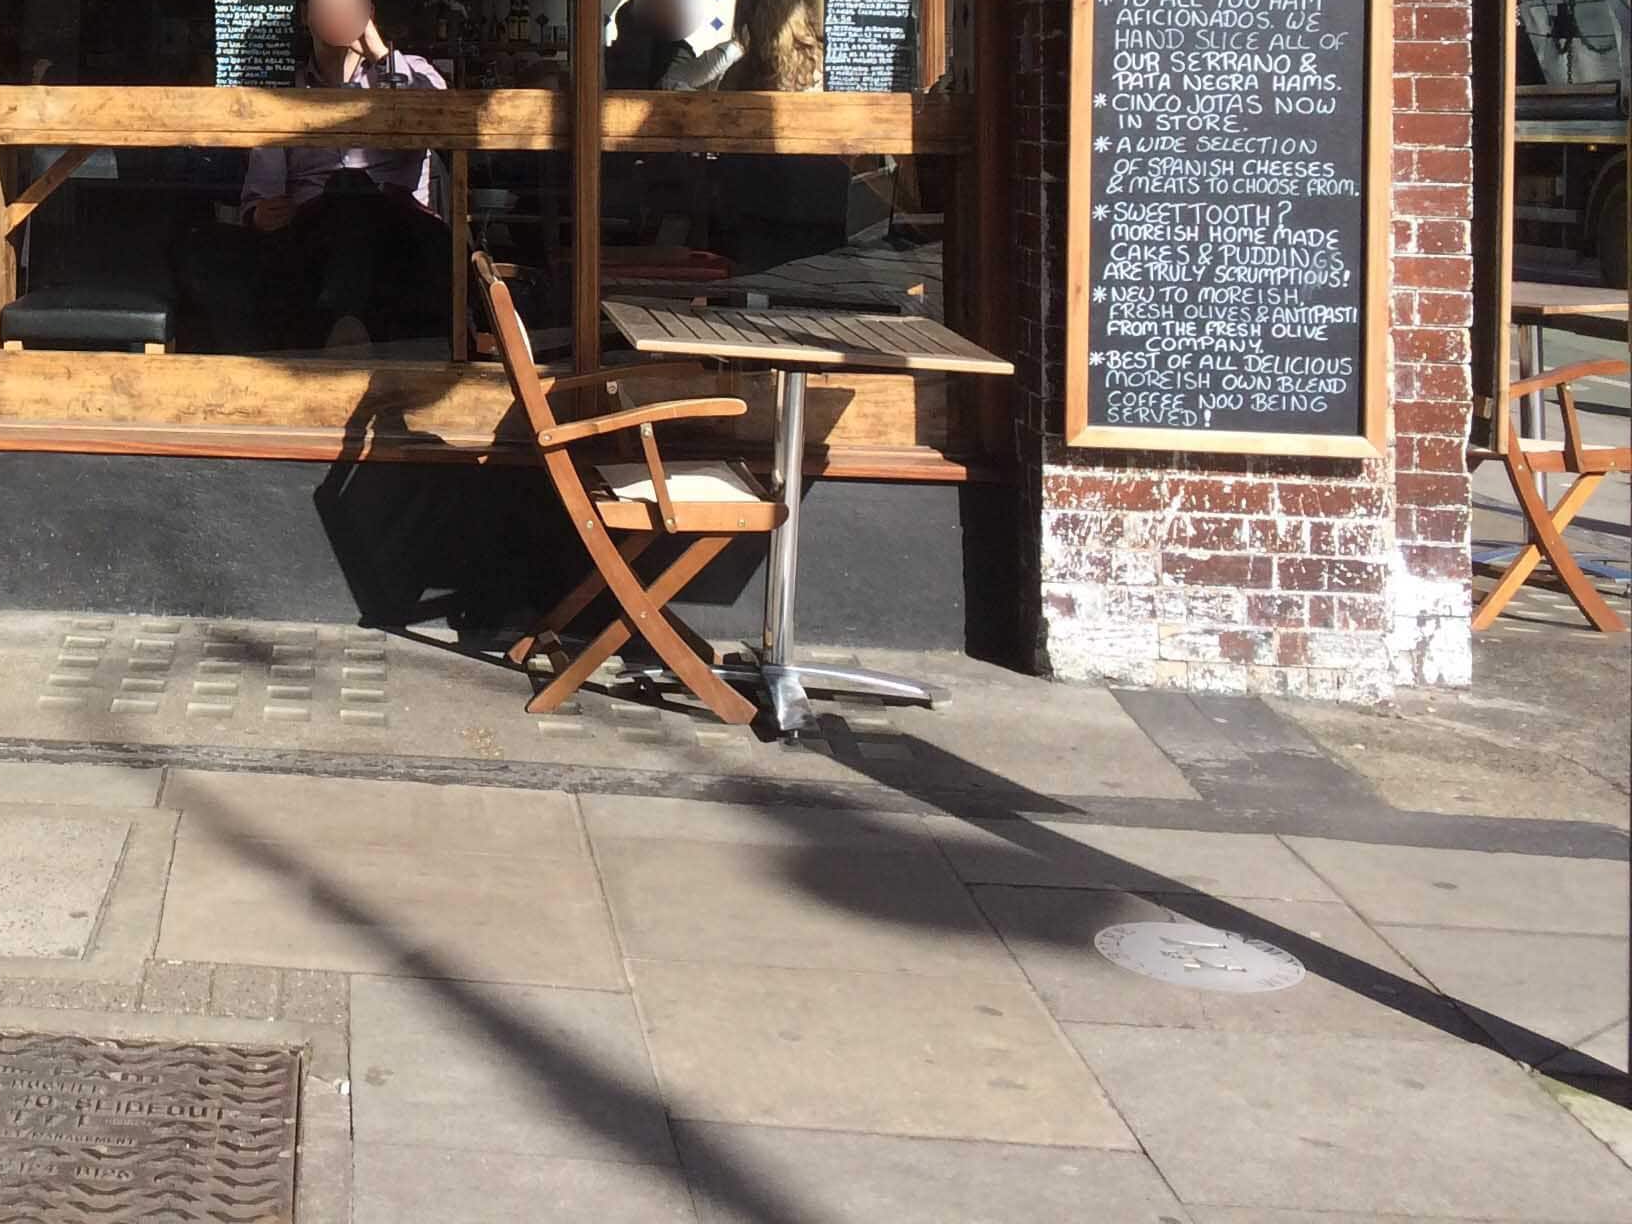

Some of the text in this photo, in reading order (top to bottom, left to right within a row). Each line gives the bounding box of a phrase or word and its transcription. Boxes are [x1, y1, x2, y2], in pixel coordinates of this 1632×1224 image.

[1116, 9, 1321, 33] AFICIONADOS. WE
[1114, 29, 1349, 51] HAND SLICE ALL OF
[1113, 51, 1318, 75] OUR SERRANO &
[1112, 73, 1342, 92] PATA NEGRA HAMS.
[1112, 93, 1337, 114] CINCO JOTAS NOW
[1119, 113, 1249, 134] IN STORE.
[1116, 136, 1317, 155] A WIDE SELECTION
[1113, 156, 1335, 178] OF SPANISH CHEESES
[1105, 175, 1361, 198] & MEATS TO CHOOSE FROM.
[1113, 201, 1186, 224] SWEET
[1110, 224, 1340, 251] MOREISH HOME MADE
[1109, 242, 1345, 271] CAKES & PUDDINGS
[1103, 261, 1351, 288] ARE TRULY SCRUMPTIOUS!
[1111, 285, 1155, 302] NEW
[1159, 286, 1189, 304] TO
[1108, 302, 1358, 324] FRESH OLIVES & ANTIPASTI
[1106, 320, 1329, 341] FROM THE FRESH OLIVE
[1145, 336, 1265, 354] COMPANY.
[1105, 350, 1353, 376] BEST OF ALL DELICIOUS
[1105, 370, 1347, 394] MOREISH OWN BLEND
[1107, 390, 1328, 412] COFFEE NOW BEING
